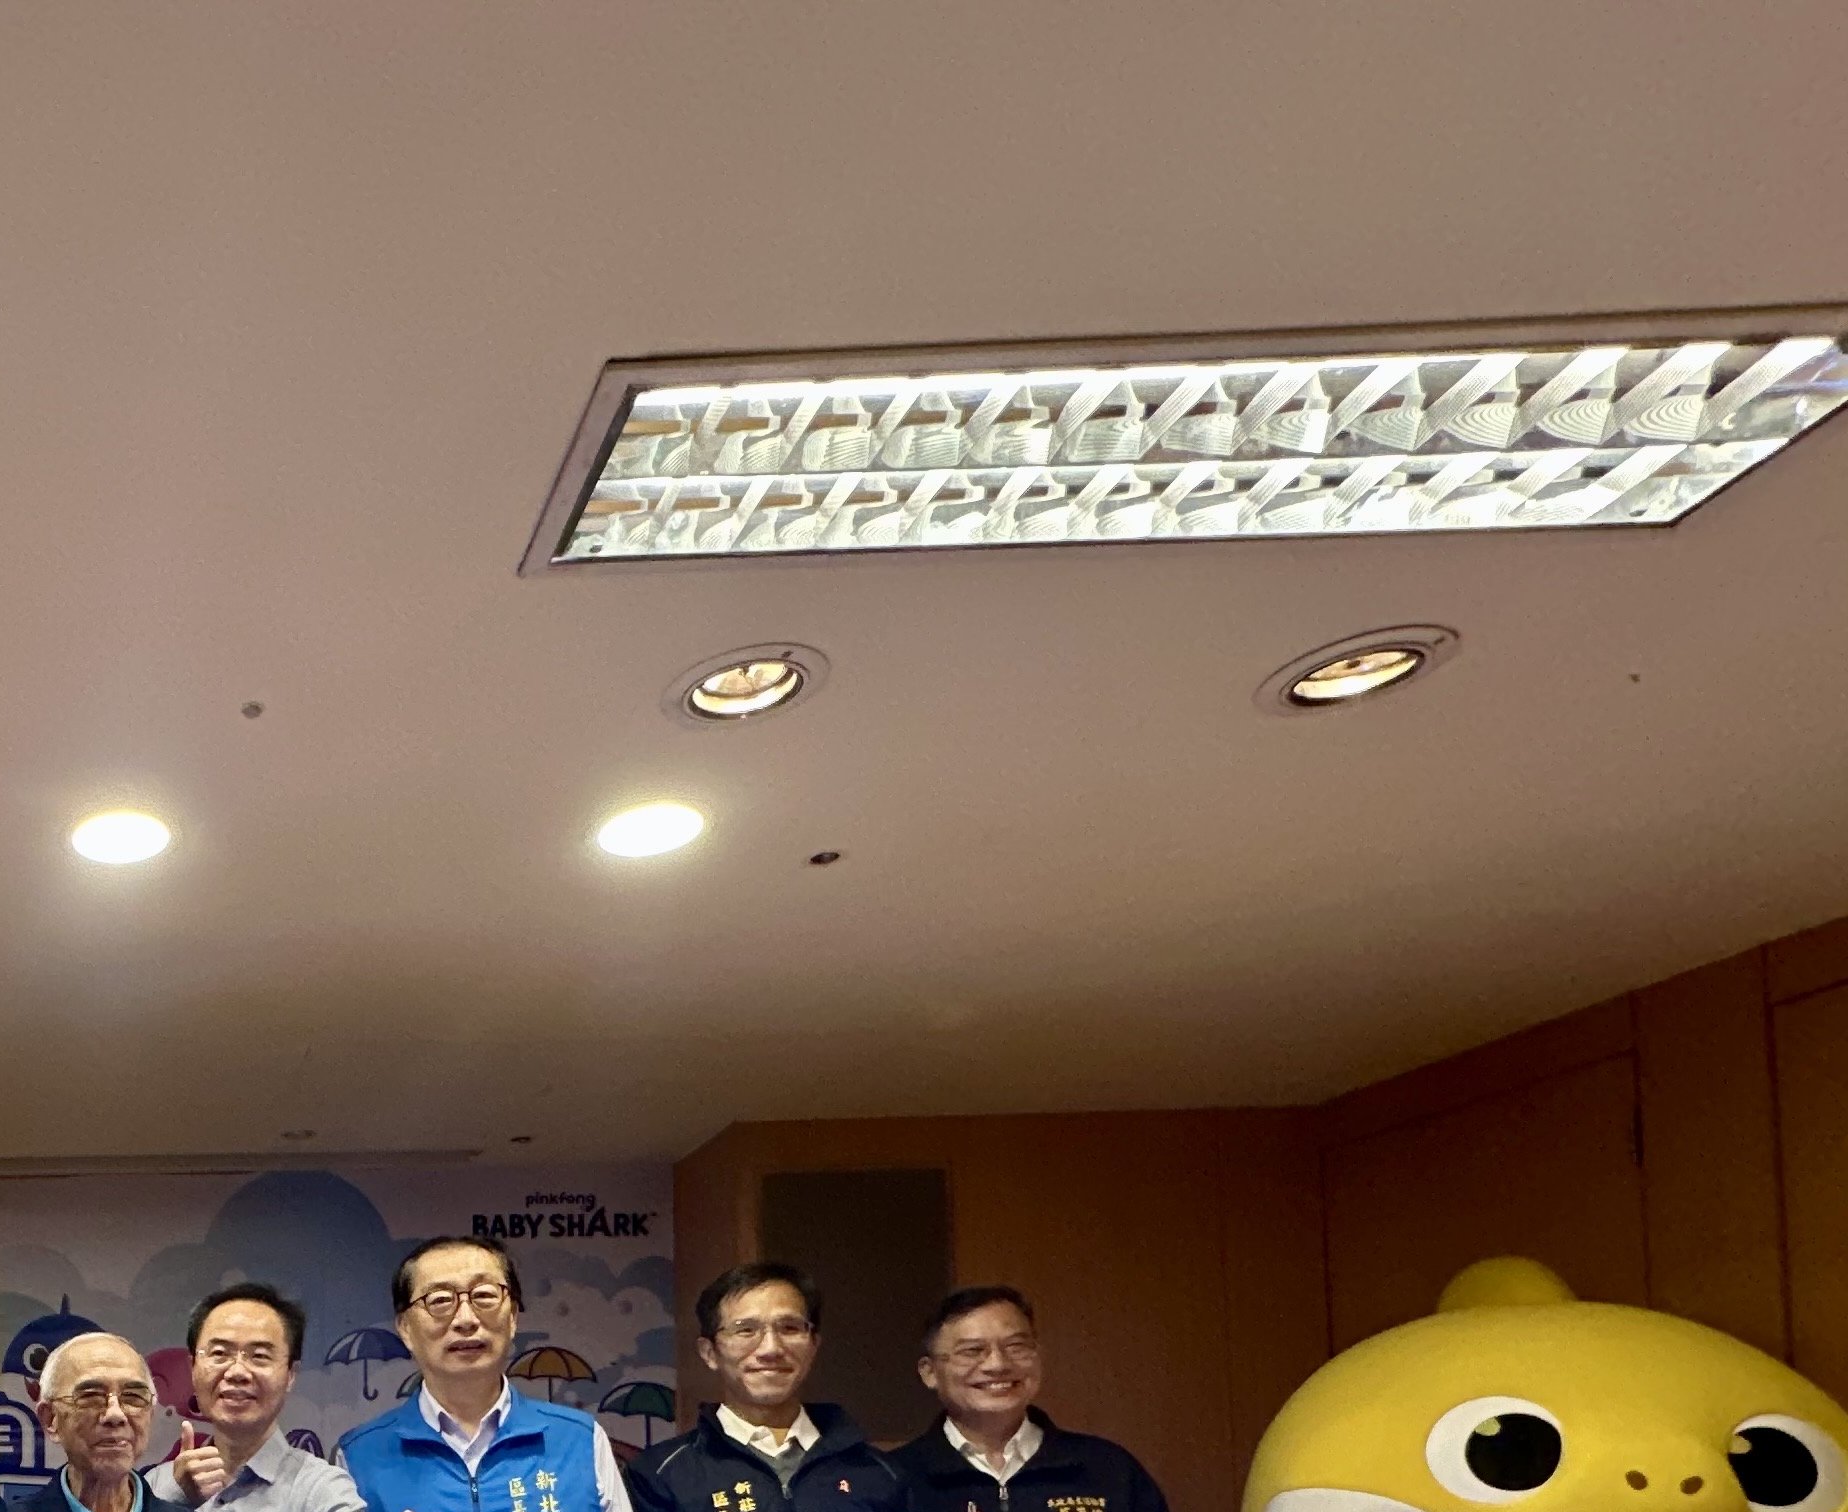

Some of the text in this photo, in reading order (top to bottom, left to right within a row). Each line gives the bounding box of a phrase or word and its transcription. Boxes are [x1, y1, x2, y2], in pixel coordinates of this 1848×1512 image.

[525, 1191, 596, 1212] pinkfong
[472, 1206, 650, 1239] BABY SHARK
